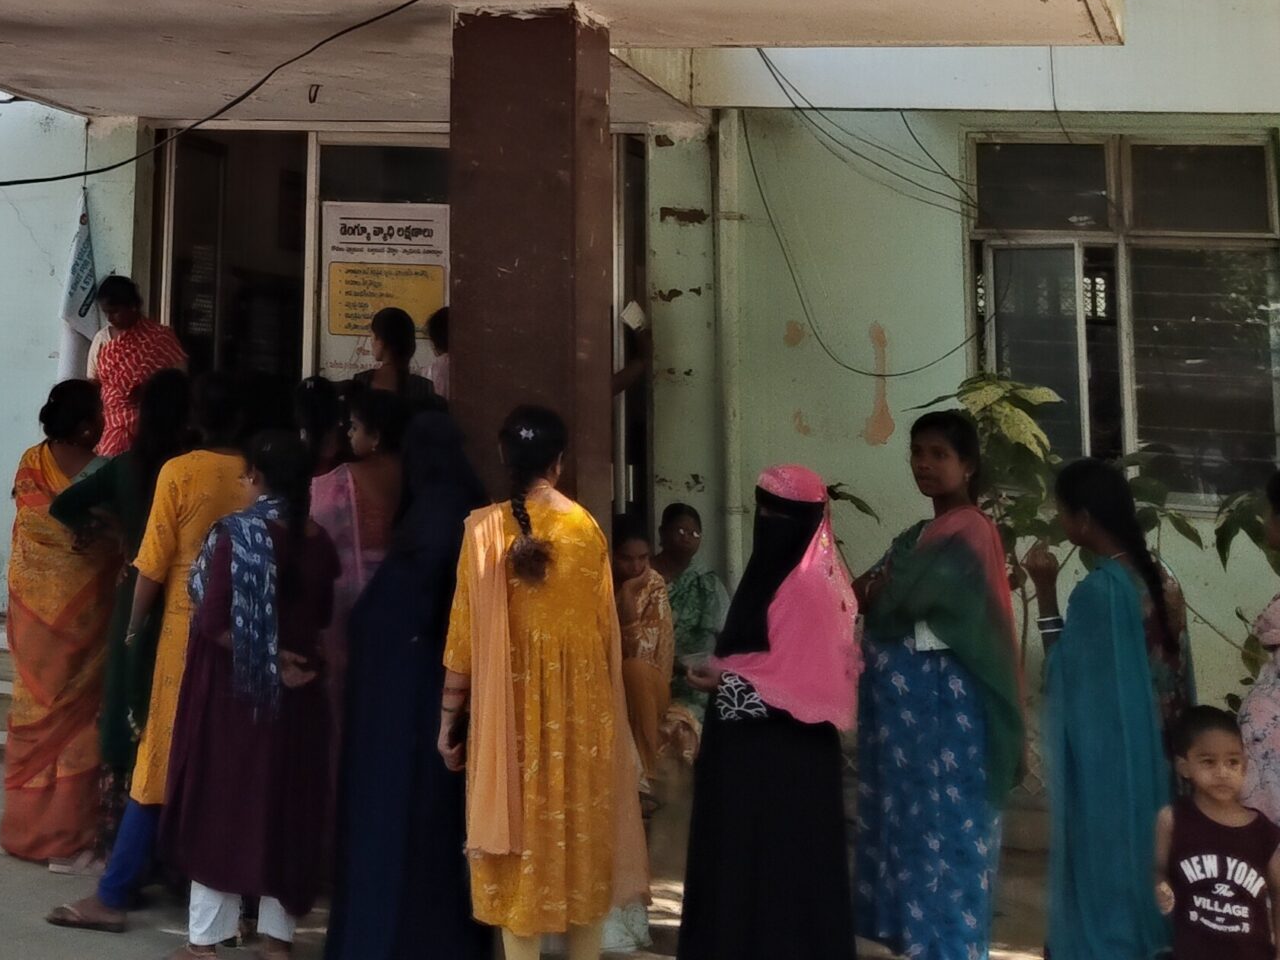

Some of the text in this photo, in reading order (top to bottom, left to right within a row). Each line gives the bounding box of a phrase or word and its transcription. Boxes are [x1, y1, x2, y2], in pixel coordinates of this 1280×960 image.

[1180, 855, 1266, 898] NEW YORK
[1211, 883, 1234, 898] The
[1193, 895, 1250, 918] VILLAGE
